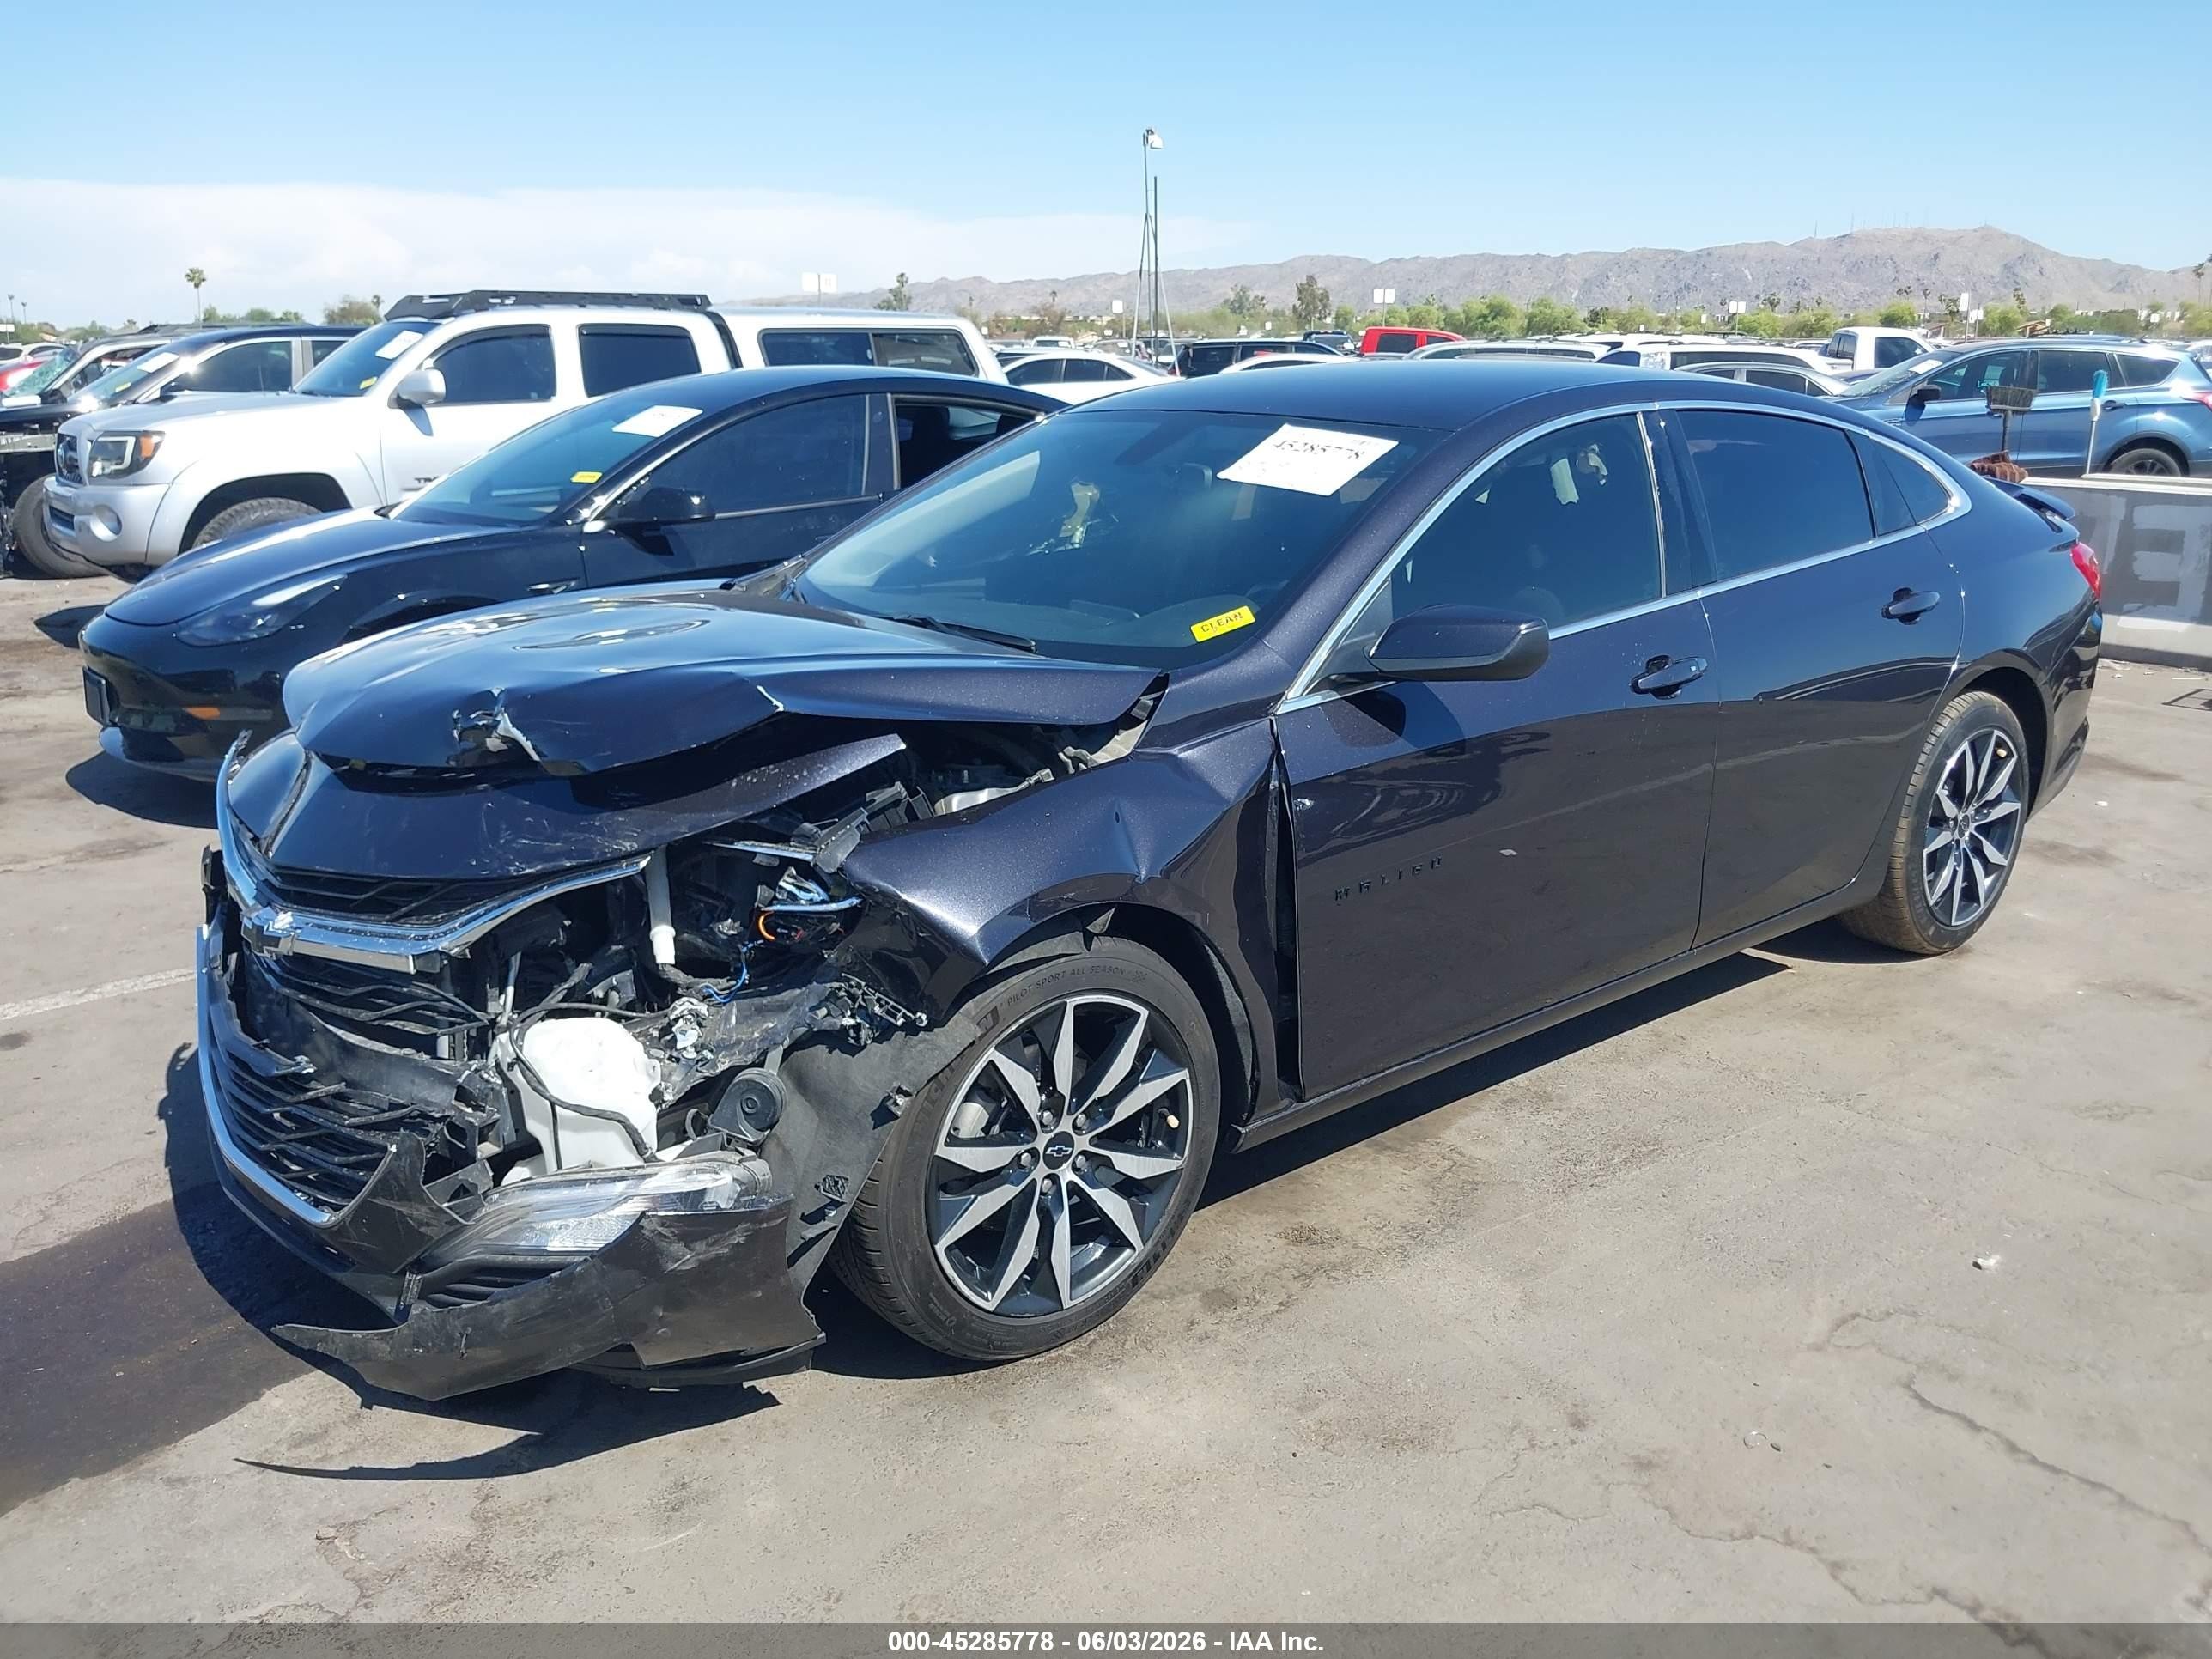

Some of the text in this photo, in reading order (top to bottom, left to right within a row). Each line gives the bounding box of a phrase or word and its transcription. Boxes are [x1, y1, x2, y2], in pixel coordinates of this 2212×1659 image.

[1200, 611, 1244, 633] CLEAN
[1006, 987, 1033, 1006] PILOT
[1036, 970, 1066, 989] SPORT
[1071, 968, 1087, 977] ALL
